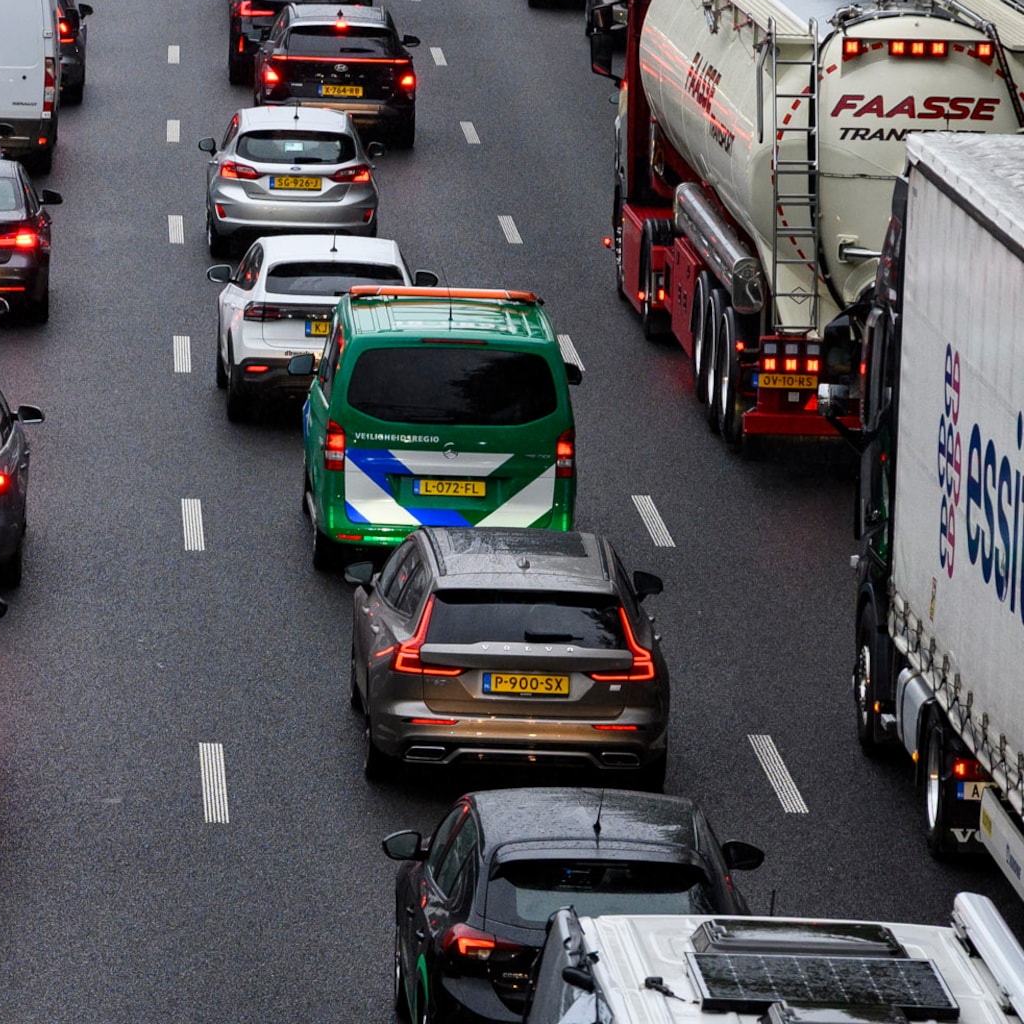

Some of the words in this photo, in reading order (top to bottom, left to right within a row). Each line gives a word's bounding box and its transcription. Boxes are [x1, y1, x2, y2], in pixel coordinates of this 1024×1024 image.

[325, 86, 359, 95] X-764-RB
[831, 95, 1000, 121] FAASSE
[278, 178, 318, 188] SG-926-J
[355, 432, 440, 444] VEILIGHEIDSREGIO
[425, 482, 478, 494] L-072-FL
[966, 411, 1024, 627] essi
[494, 677, 563, 692] P-900-SX
